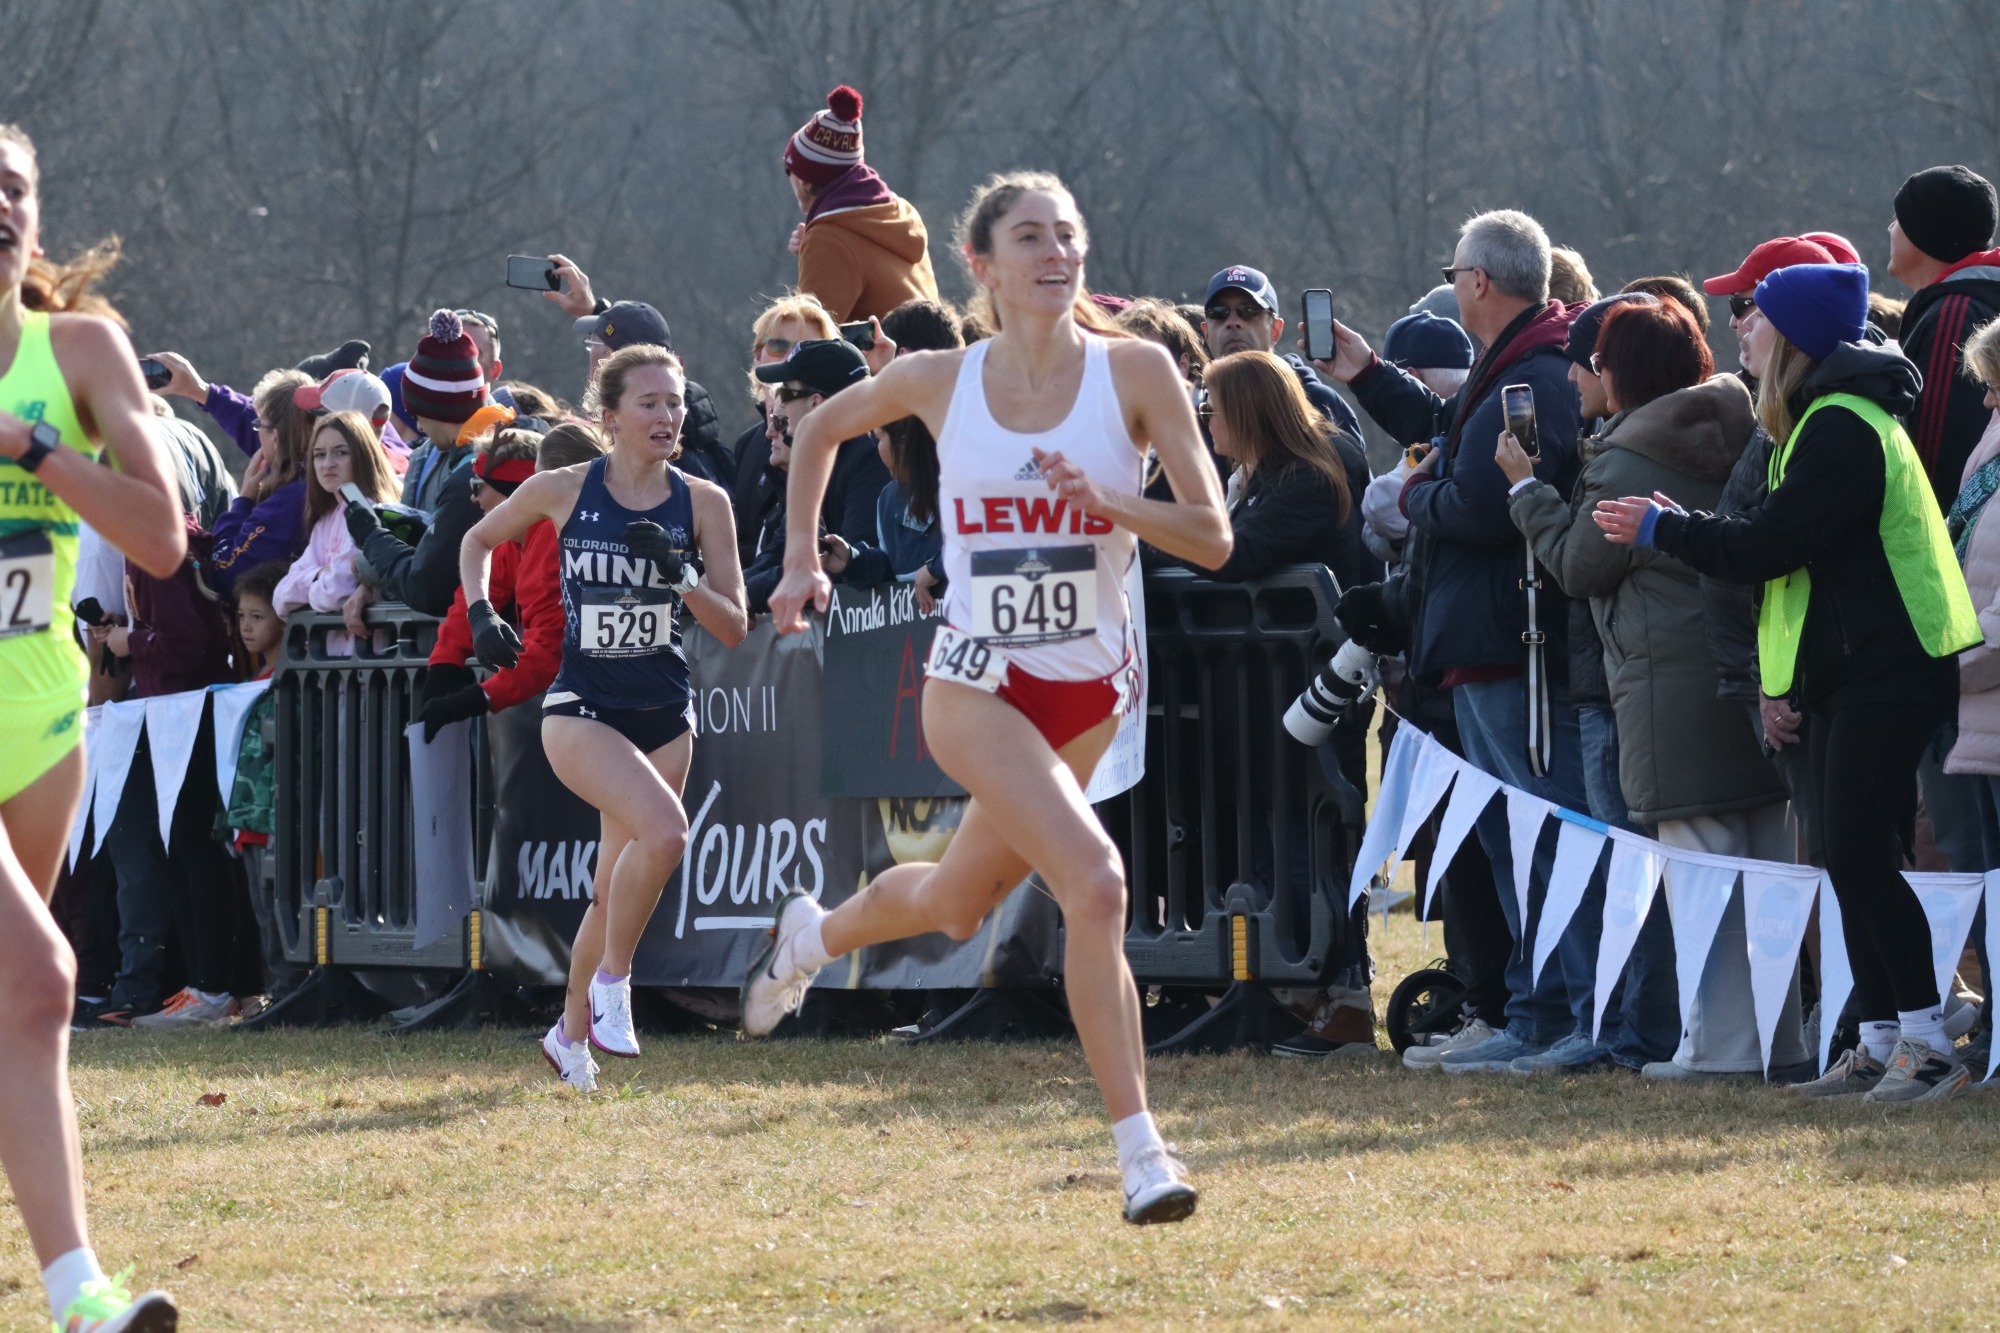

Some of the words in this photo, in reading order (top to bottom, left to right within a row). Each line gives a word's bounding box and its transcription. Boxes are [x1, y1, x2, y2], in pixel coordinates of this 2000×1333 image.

[953, 497, 1114, 535] LEWIS
[563, 537, 629, 554] COLORADO
[0, 568, 32, 627] 2
[991, 581, 1077, 635] 649
[597, 611, 657, 648] 529
[933, 632, 991, 682] 649
[693, 686, 750, 734] ION
[517, 839, 600, 900] MAK
[674, 780, 827, 939] YOURS
